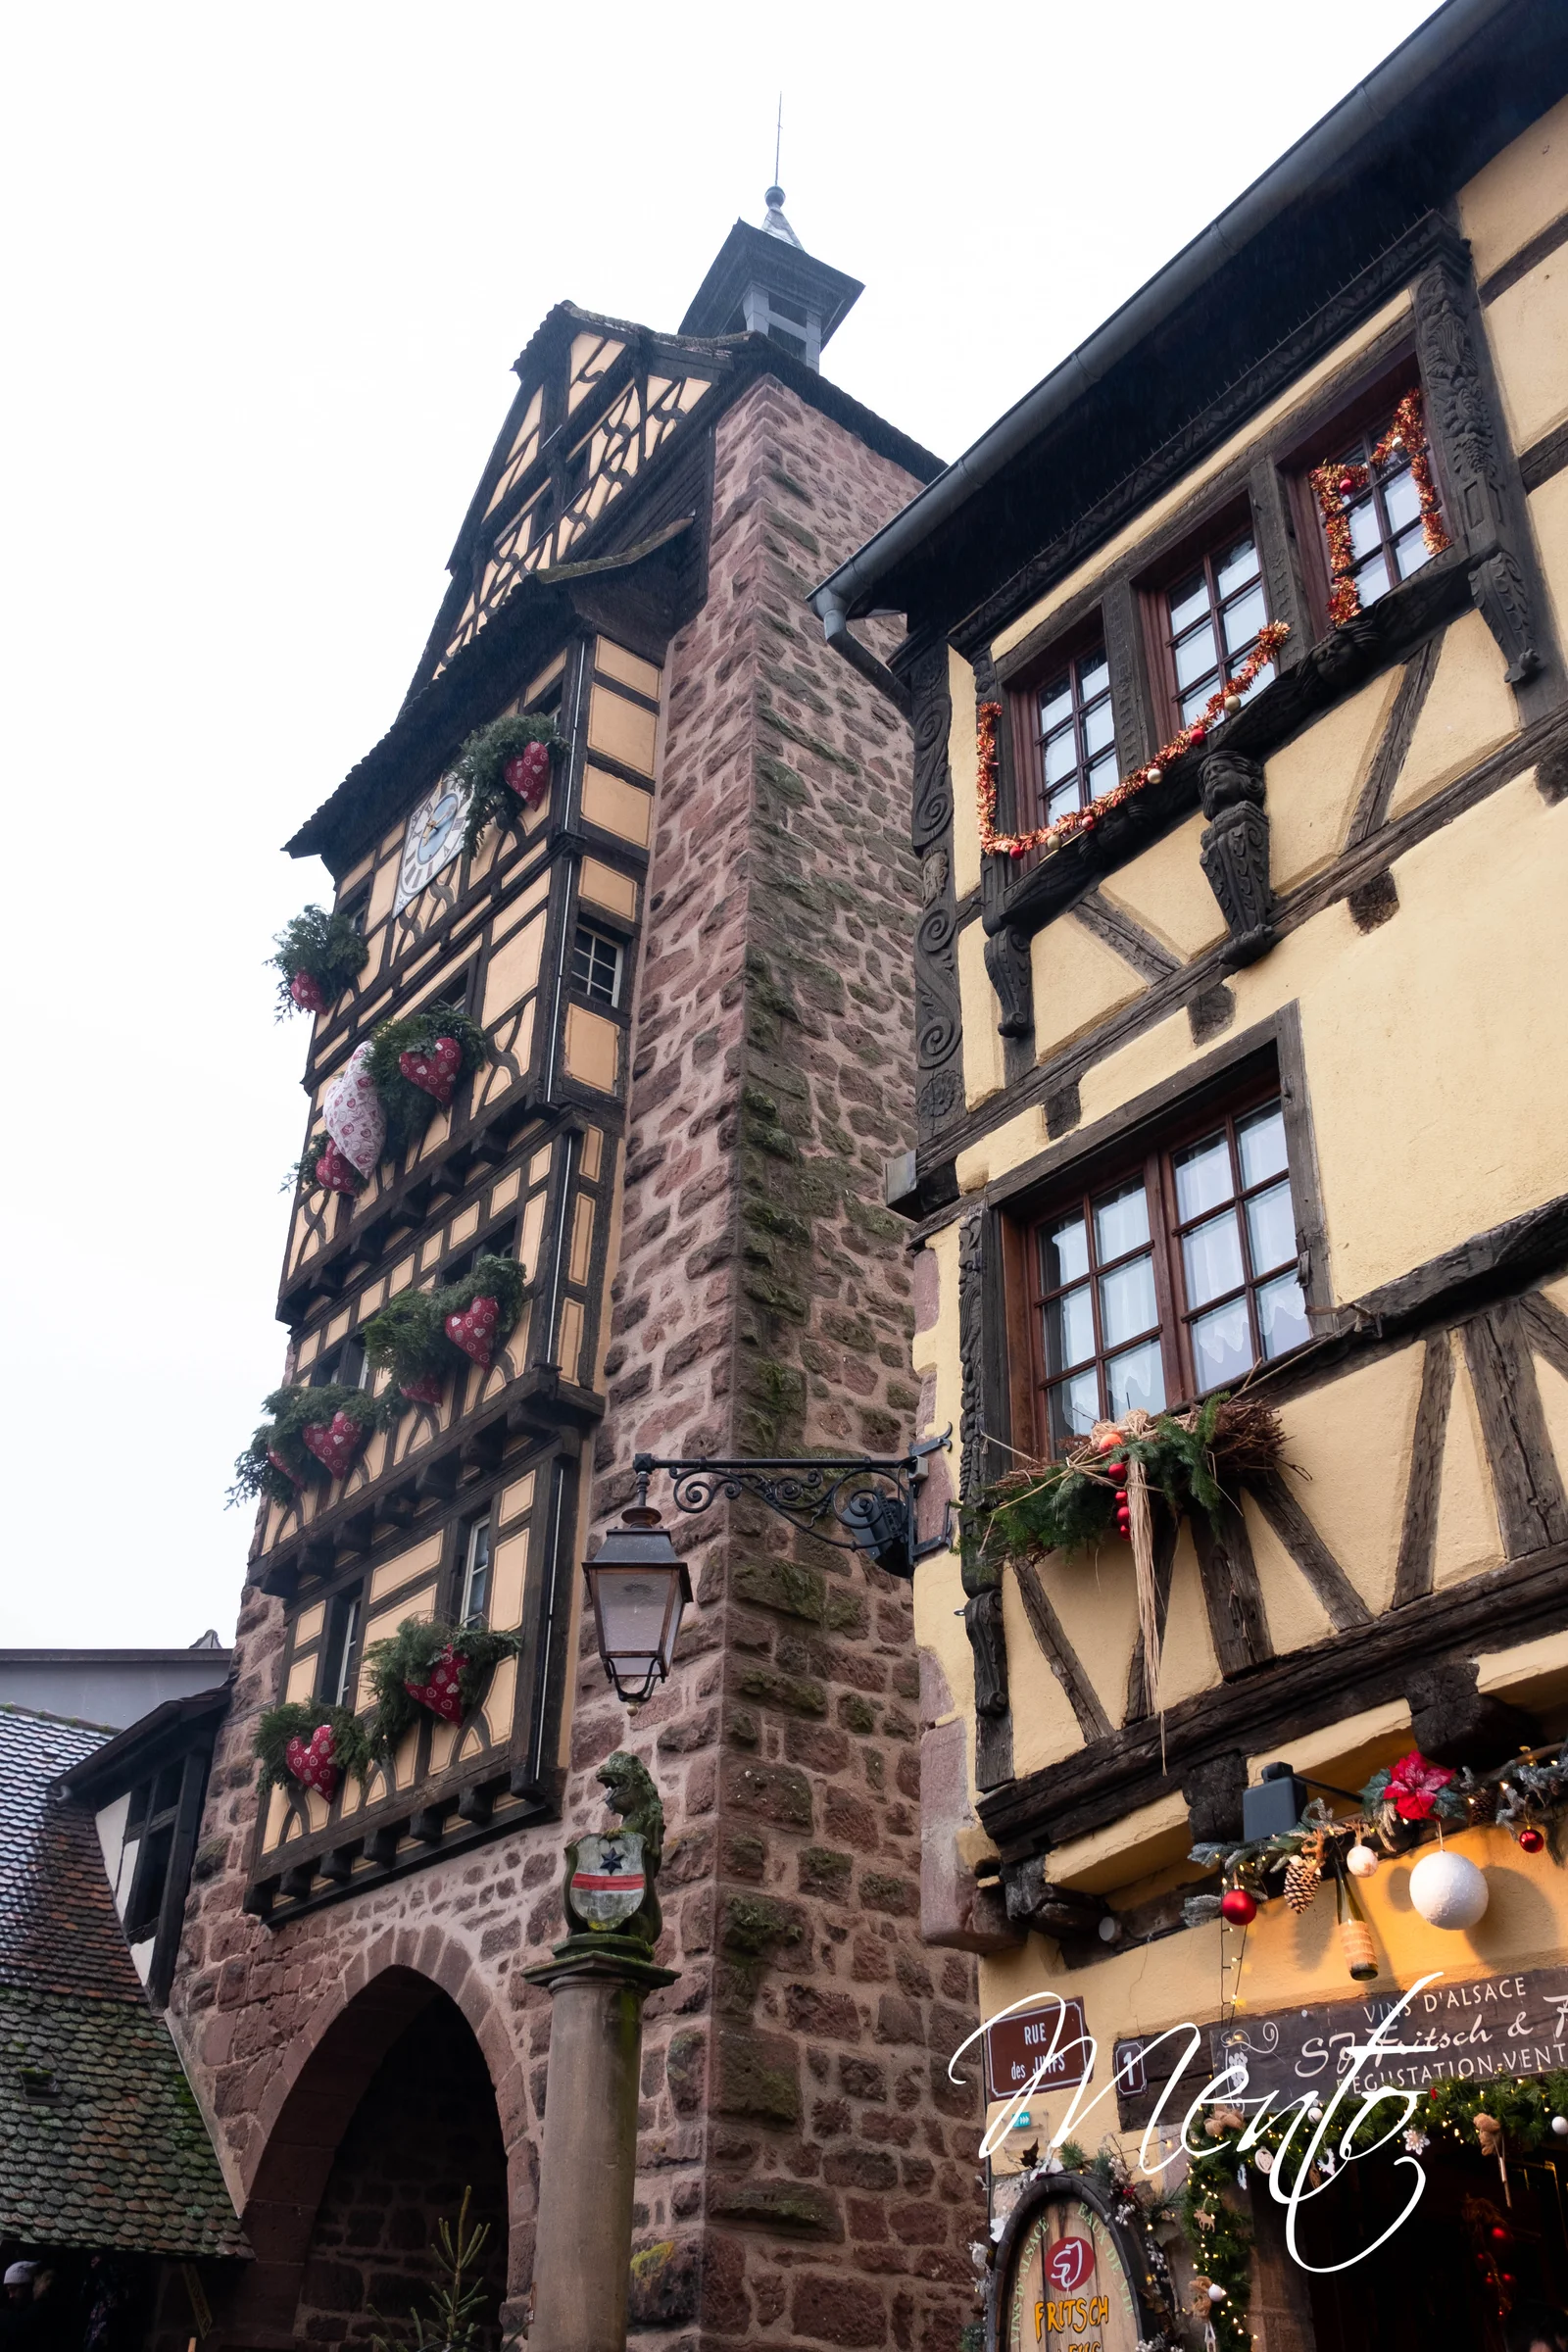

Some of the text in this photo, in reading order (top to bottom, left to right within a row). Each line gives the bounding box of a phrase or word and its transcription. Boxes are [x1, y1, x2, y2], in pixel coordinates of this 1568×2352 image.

[1363, 1977, 1527, 2024] VINS D'ALSACE
[1024, 2022, 1047, 2046] RUE
[1506, 2011, 1535, 2037] &
[1010, 2061, 1026, 2081] des
[1123, 2051, 1135, 2086] 1
[1010, 2216, 1050, 2344] VINS D'ALSACE
[1077, 2202, 1135, 2318] EAUX DE VIE
[1035, 2294, 1109, 2343] FRITSCH
